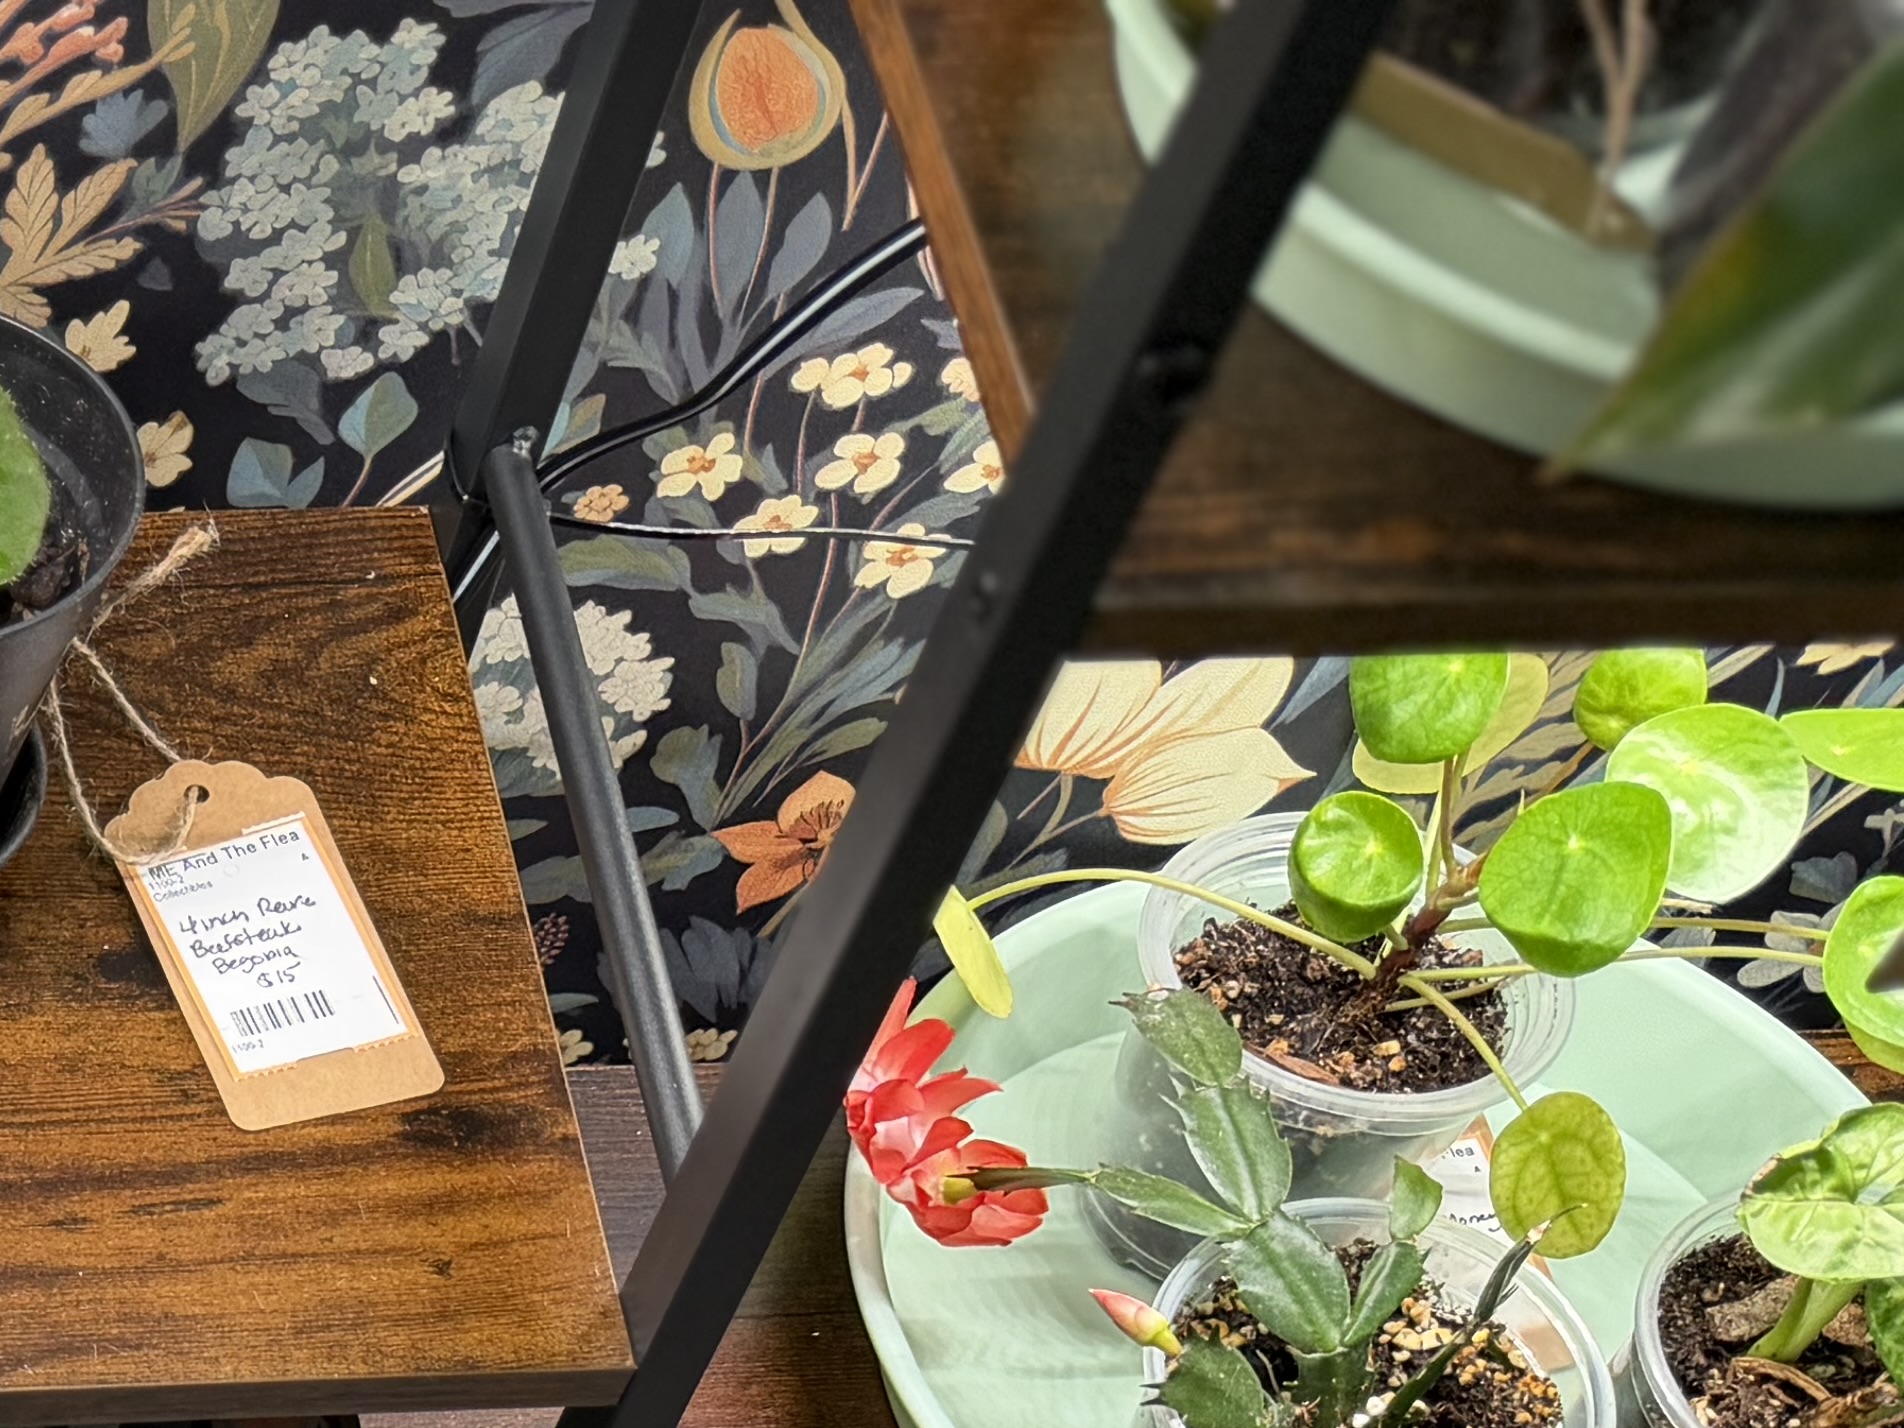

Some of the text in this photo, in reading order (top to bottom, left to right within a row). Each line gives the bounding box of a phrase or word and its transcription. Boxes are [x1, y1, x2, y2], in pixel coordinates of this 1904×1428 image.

[148, 830, 300, 880] ME And The Flea
[179, 914, 197, 934] 4
